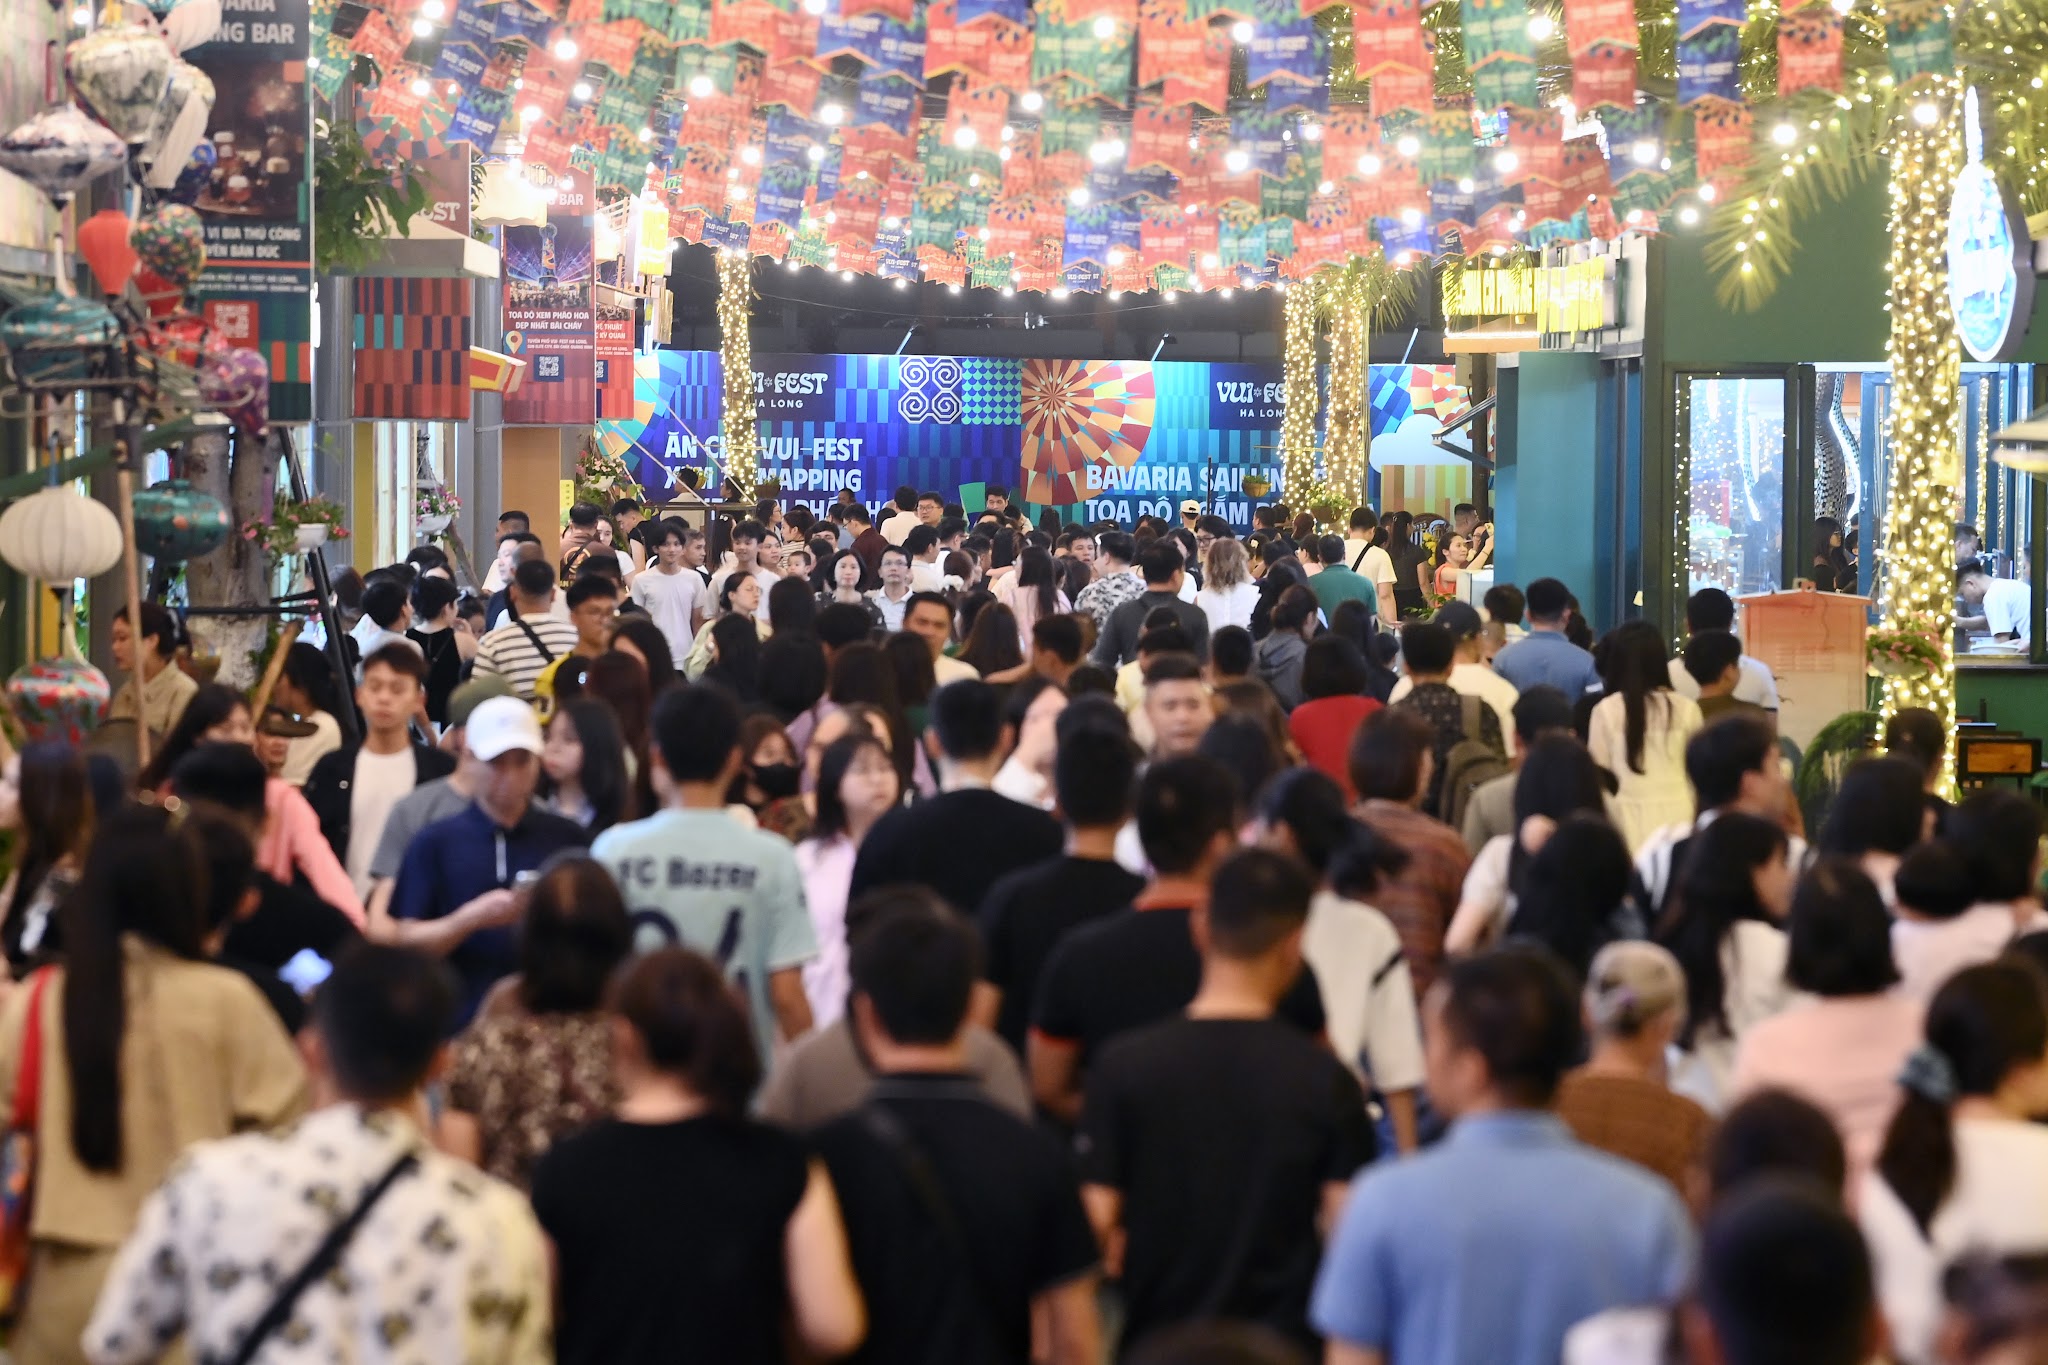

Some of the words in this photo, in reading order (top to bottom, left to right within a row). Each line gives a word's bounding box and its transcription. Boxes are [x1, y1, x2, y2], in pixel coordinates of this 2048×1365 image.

[251, 22, 295, 44] BAR
[559, 193, 584, 206] BAR
[536, 311, 551, 320] XEM
[574, 311, 589, 320] HOA
[774, 372, 828, 395] FEST
[1216, 381, 1254, 404] VUI
[1263, 382, 1286, 404] FE
[770, 399, 804, 409] LONG
[1240, 409, 1255, 418] HA
[1260, 409, 1286, 418] LON
[664, 431, 698, 459] ĂN
[757, 467, 862, 493] MAPPING
[1087, 464, 1193, 492] BAVARIA
